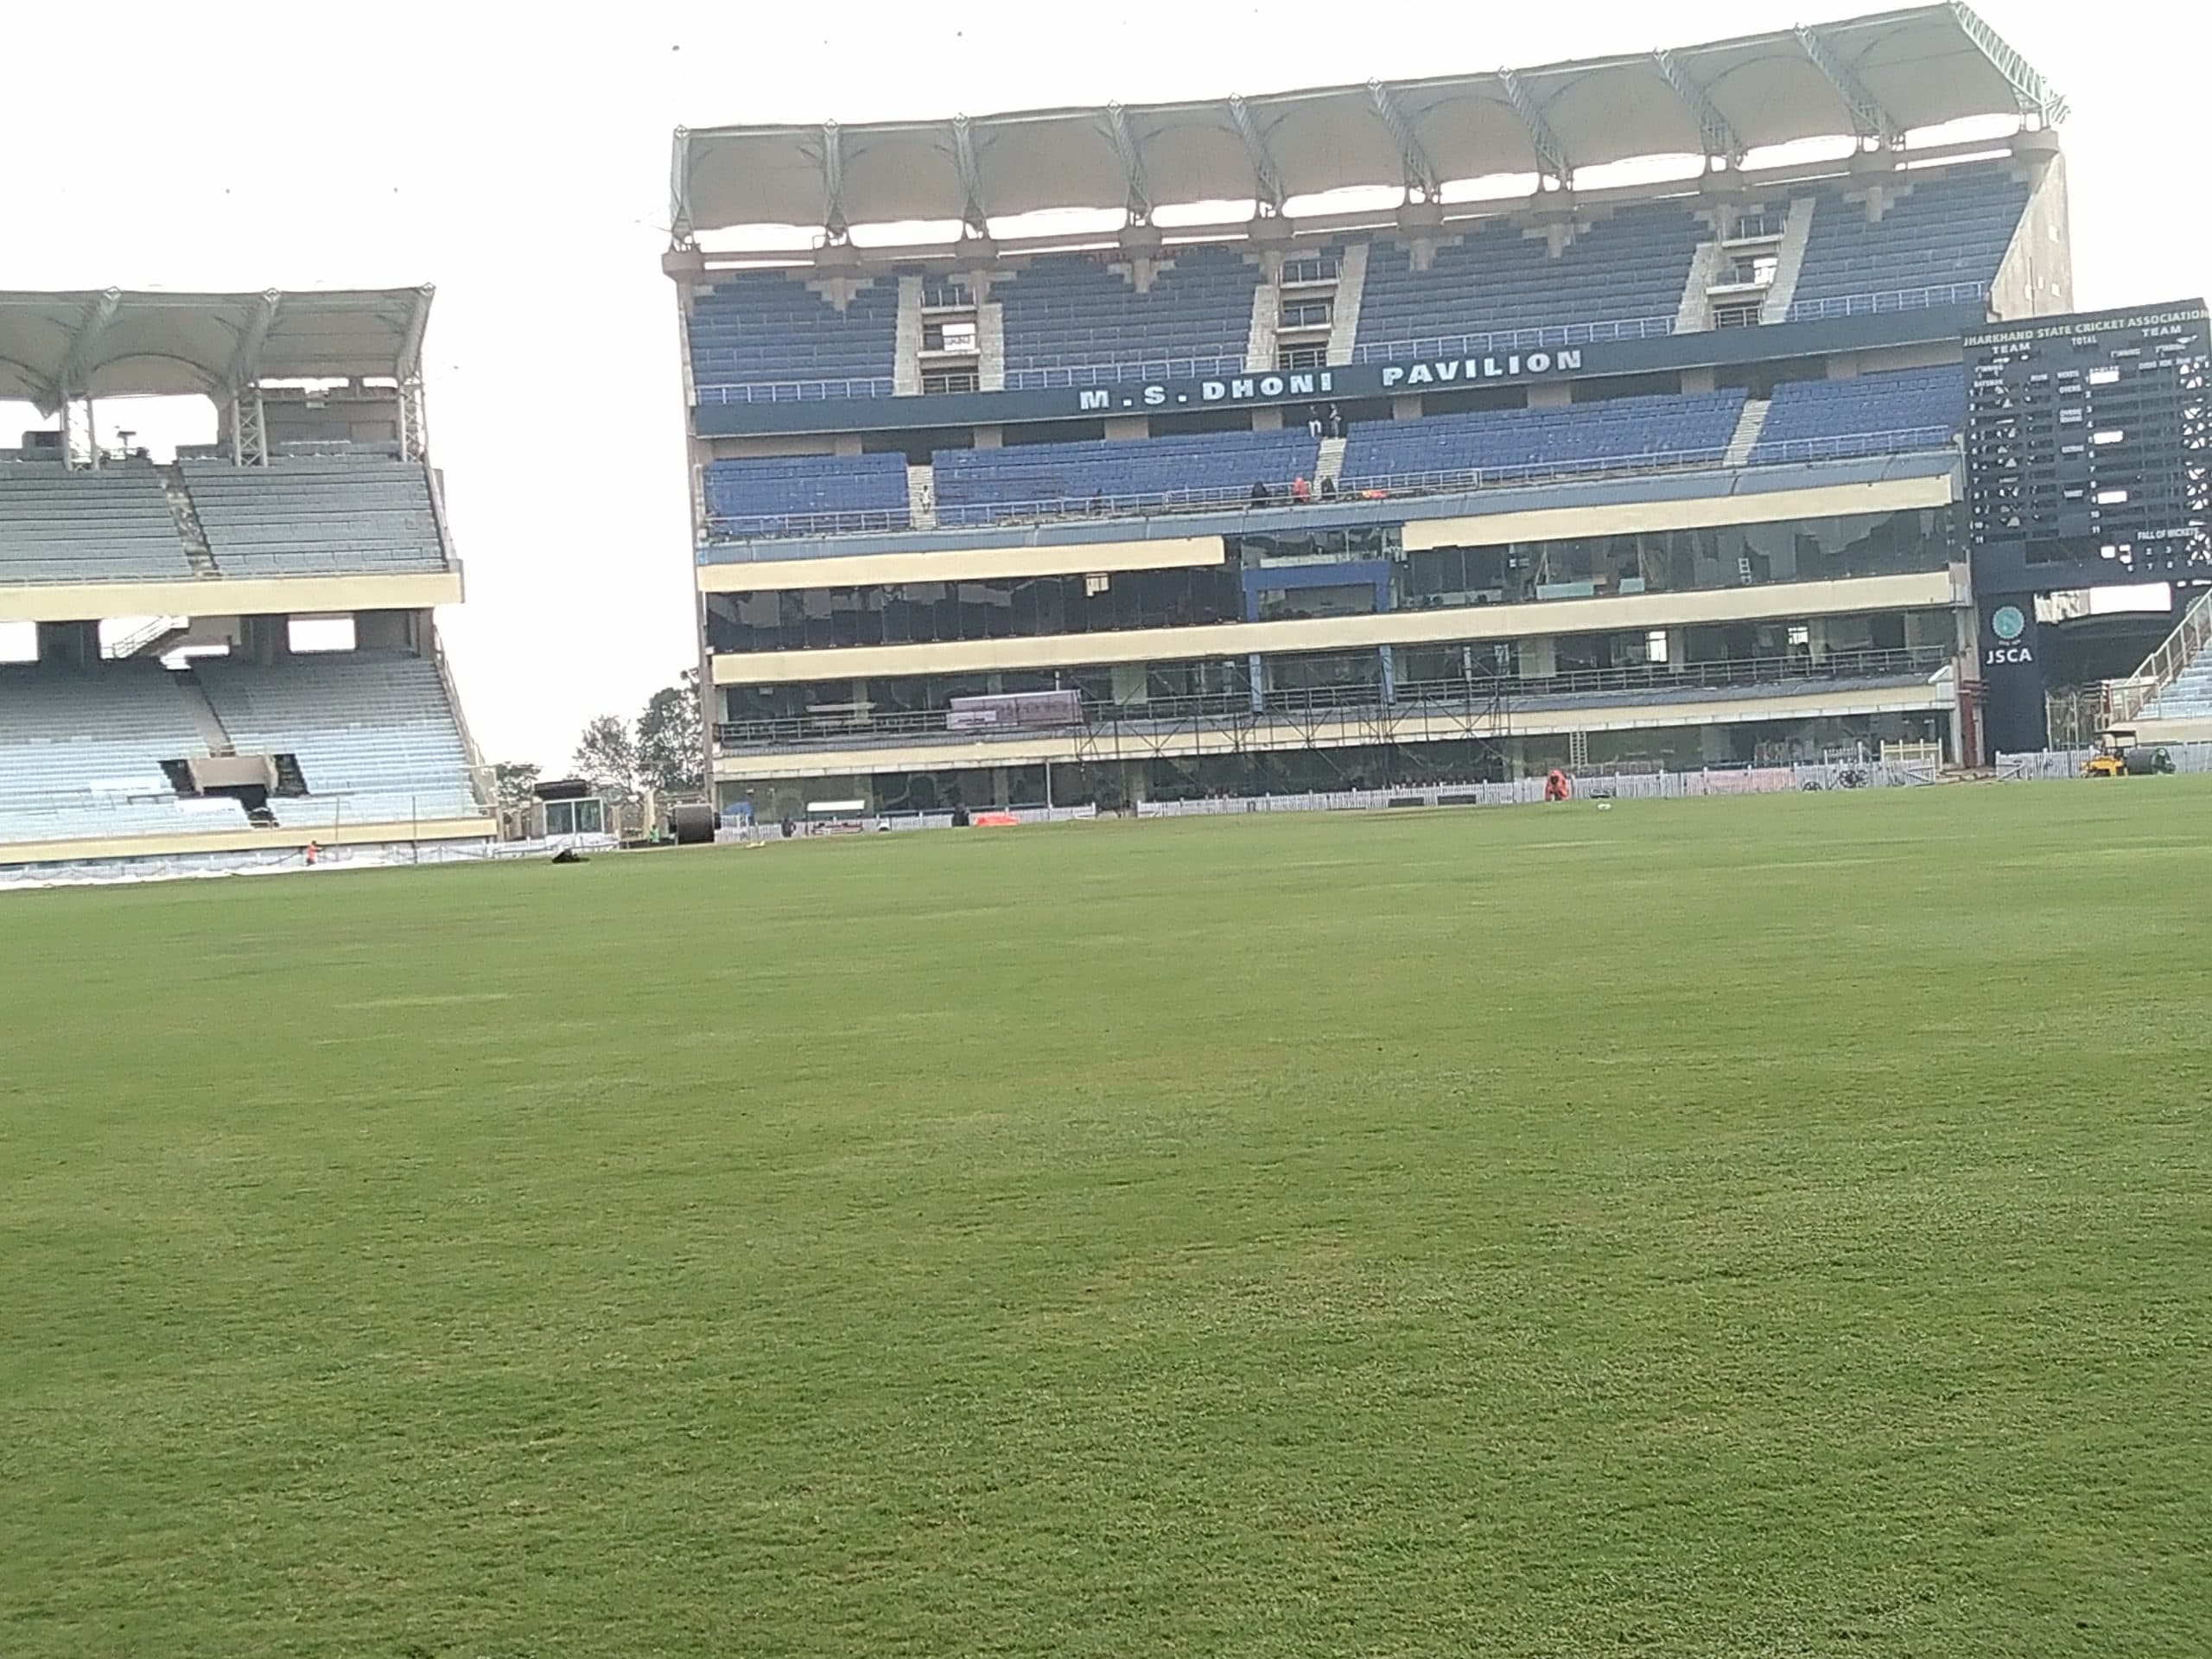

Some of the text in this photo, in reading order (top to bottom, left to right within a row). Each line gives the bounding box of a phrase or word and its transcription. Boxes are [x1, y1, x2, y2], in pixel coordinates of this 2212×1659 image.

[1963, 309, 2209, 346] JHARKHAND STATE CRICKET ASSOCIATION
[2142, 325, 2182, 338] TEAM
[1991, 342, 2031, 354] TEAM
[2071, 335, 2097, 346] TOTAL
[1382, 349, 1581, 386] PAVILION
[1986, 647, 2032, 664] JSCA
